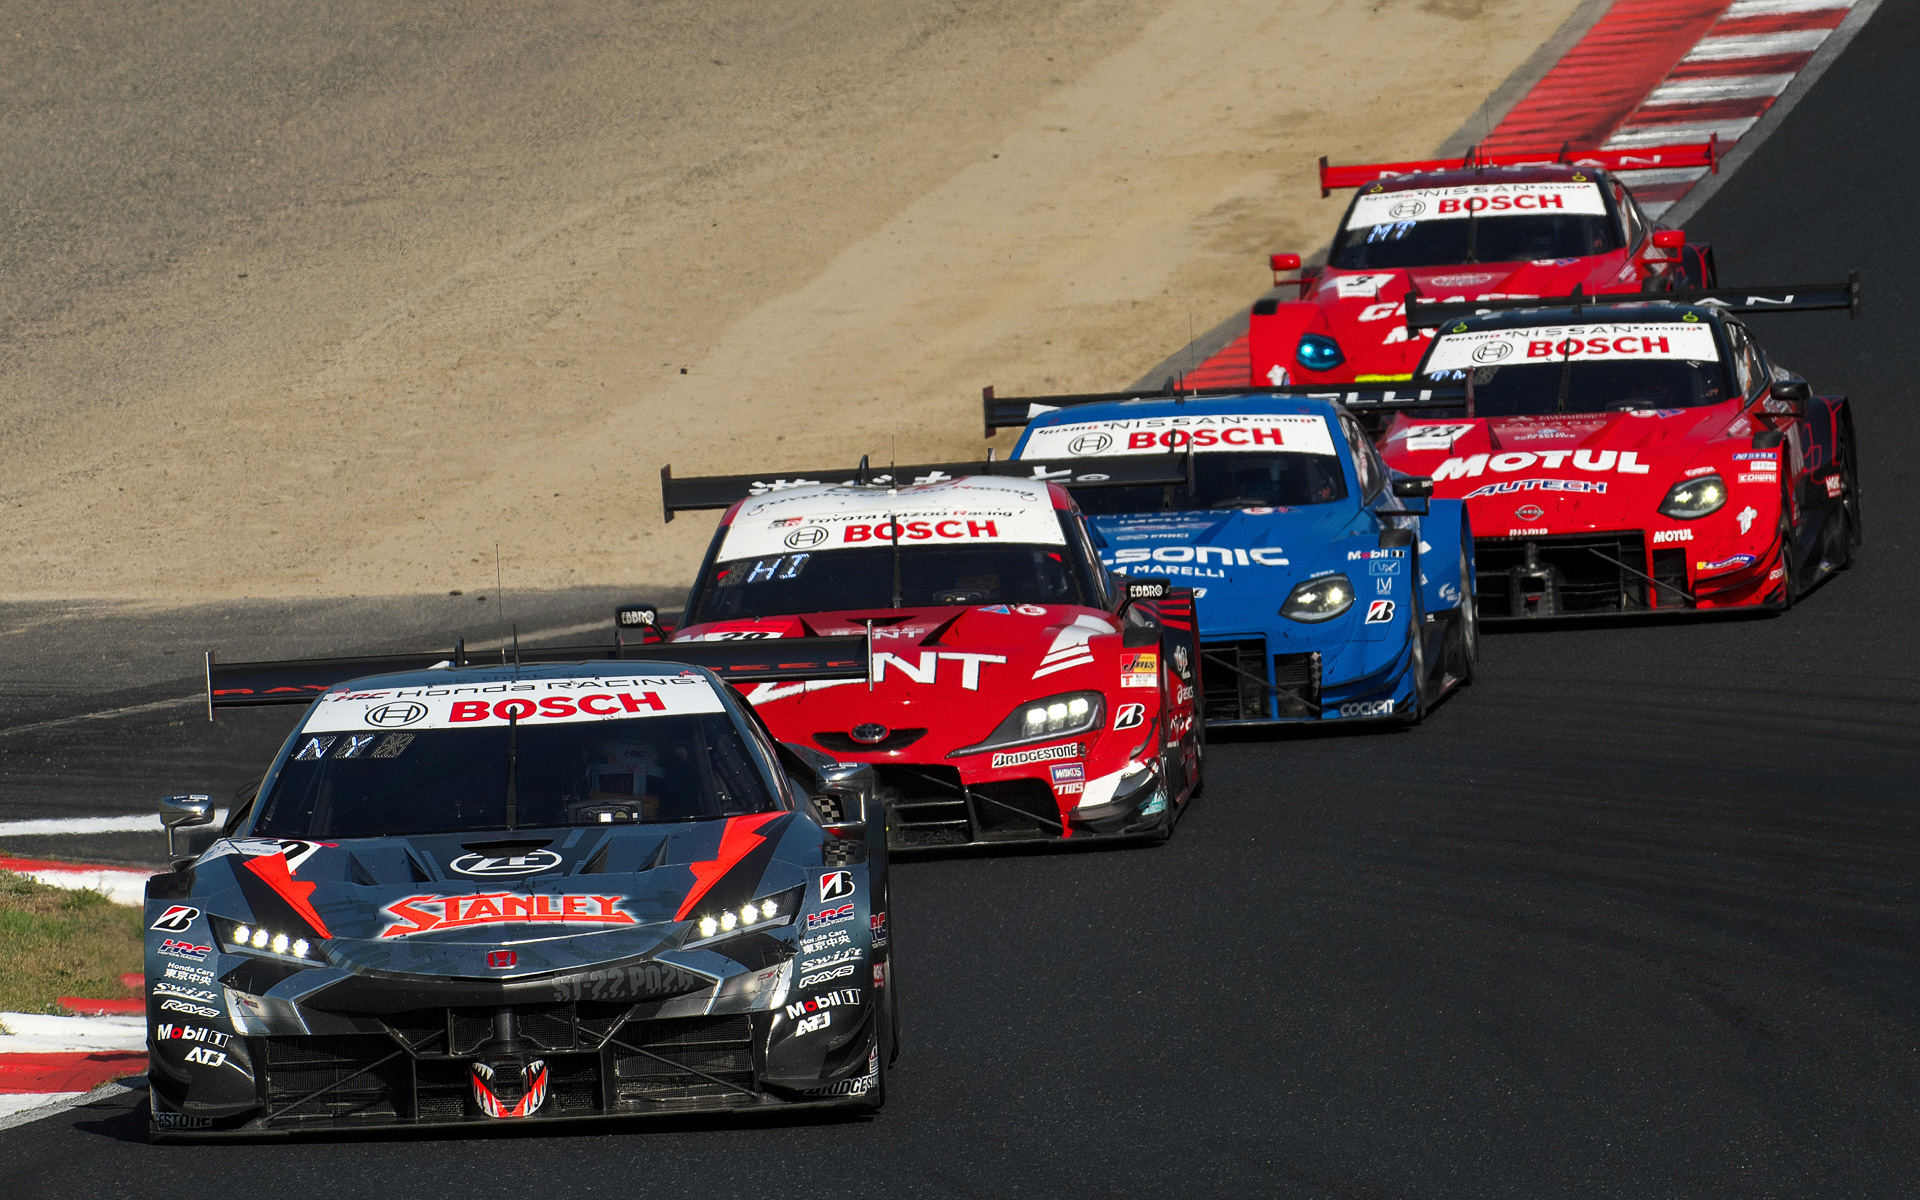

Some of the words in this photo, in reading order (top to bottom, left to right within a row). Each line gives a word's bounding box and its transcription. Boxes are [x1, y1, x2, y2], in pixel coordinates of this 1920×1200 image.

[1423, 185, 1529, 198] NISSAN
[1438, 194, 1563, 214] BOSCH
[1512, 325, 1631, 338] NISSAN
[1527, 336, 1670, 357] BOSCH
[1110, 416, 1240, 431] NISSAN
[1128, 427, 1284, 449] BOSCH
[1431, 450, 1650, 481] MOTUL
[1462, 478, 1608, 500] AUTECH
[807, 514, 878, 524] TOYOTA
[953, 510, 1012, 518] Racing
[843, 520, 998, 543] BOSCH
[1653, 528, 1694, 543] MOTUL
[1347, 550, 1388, 560] Mobil
[1133, 565, 1225, 578] MARELLI
[1130, 584, 1163, 598] EBBRO
[397, 683, 535, 698] Honda
[547, 678, 696, 690] RACING
[448, 691, 667, 722] BOSCH
[992, 743, 1077, 768] BRIDGESTONE
[381, 892, 637, 938] STANLEY
[828, 929, 848, 938] Cars
[164, 968, 212, 986] 東京中央
[167, 961, 195, 973] Honda
[196, 967, 215, 977] Cars
[799, 965, 855, 988] RAYS
[161, 999, 220, 1018] RAYS
[786, 991, 842, 1020] Mobil
[157, 1023, 208, 1041] Mobil
